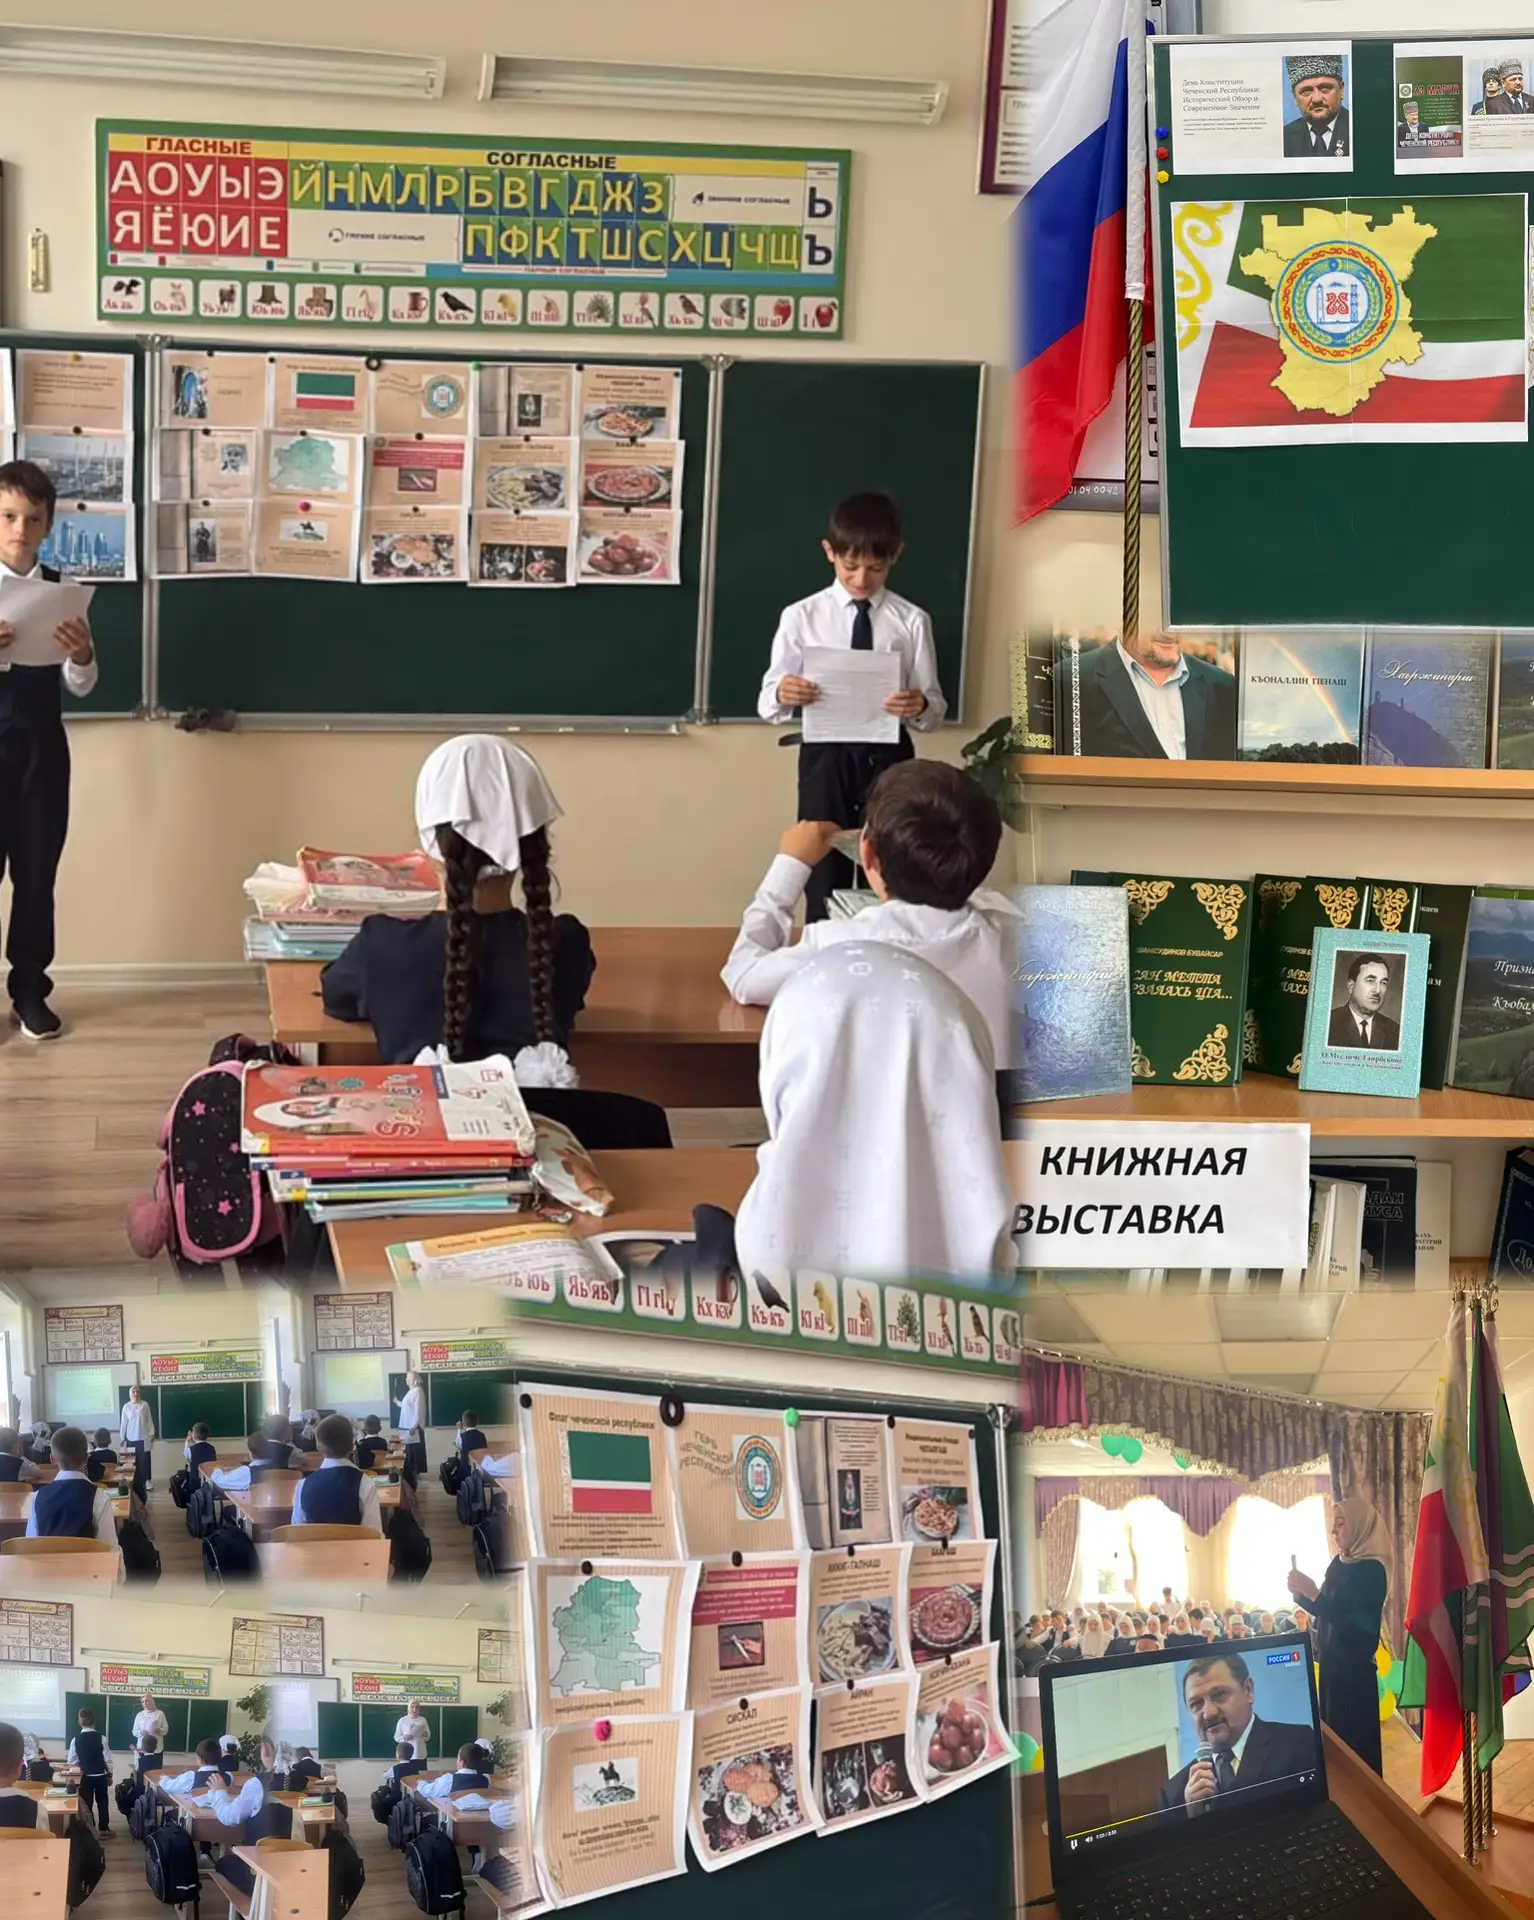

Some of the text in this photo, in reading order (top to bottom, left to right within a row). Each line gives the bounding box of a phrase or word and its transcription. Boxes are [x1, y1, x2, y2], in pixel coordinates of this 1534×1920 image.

[1427, 84, 1460, 95] МАРТА
[145, 136, 252, 156] ГЛАСНЫЕ
[487, 151, 617, 170] СОГЛАСНЫЕ
[1251, 675, 1309, 686] КЪОНАЛЛИН
[1187, 949, 1224, 958] БУВАЙСАР
[1040, 1146, 1248, 1176] КНИЖНАЯ
[1012, 1204, 1225, 1235] ВЫСТАВКА
[548, 1412, 568, 1423] Флаг
[612, 1419, 655, 1431] республики
[694, 1430, 718, 1450] ГЕРБ
[1268, 1654, 1290, 1664] РОССИЯ
